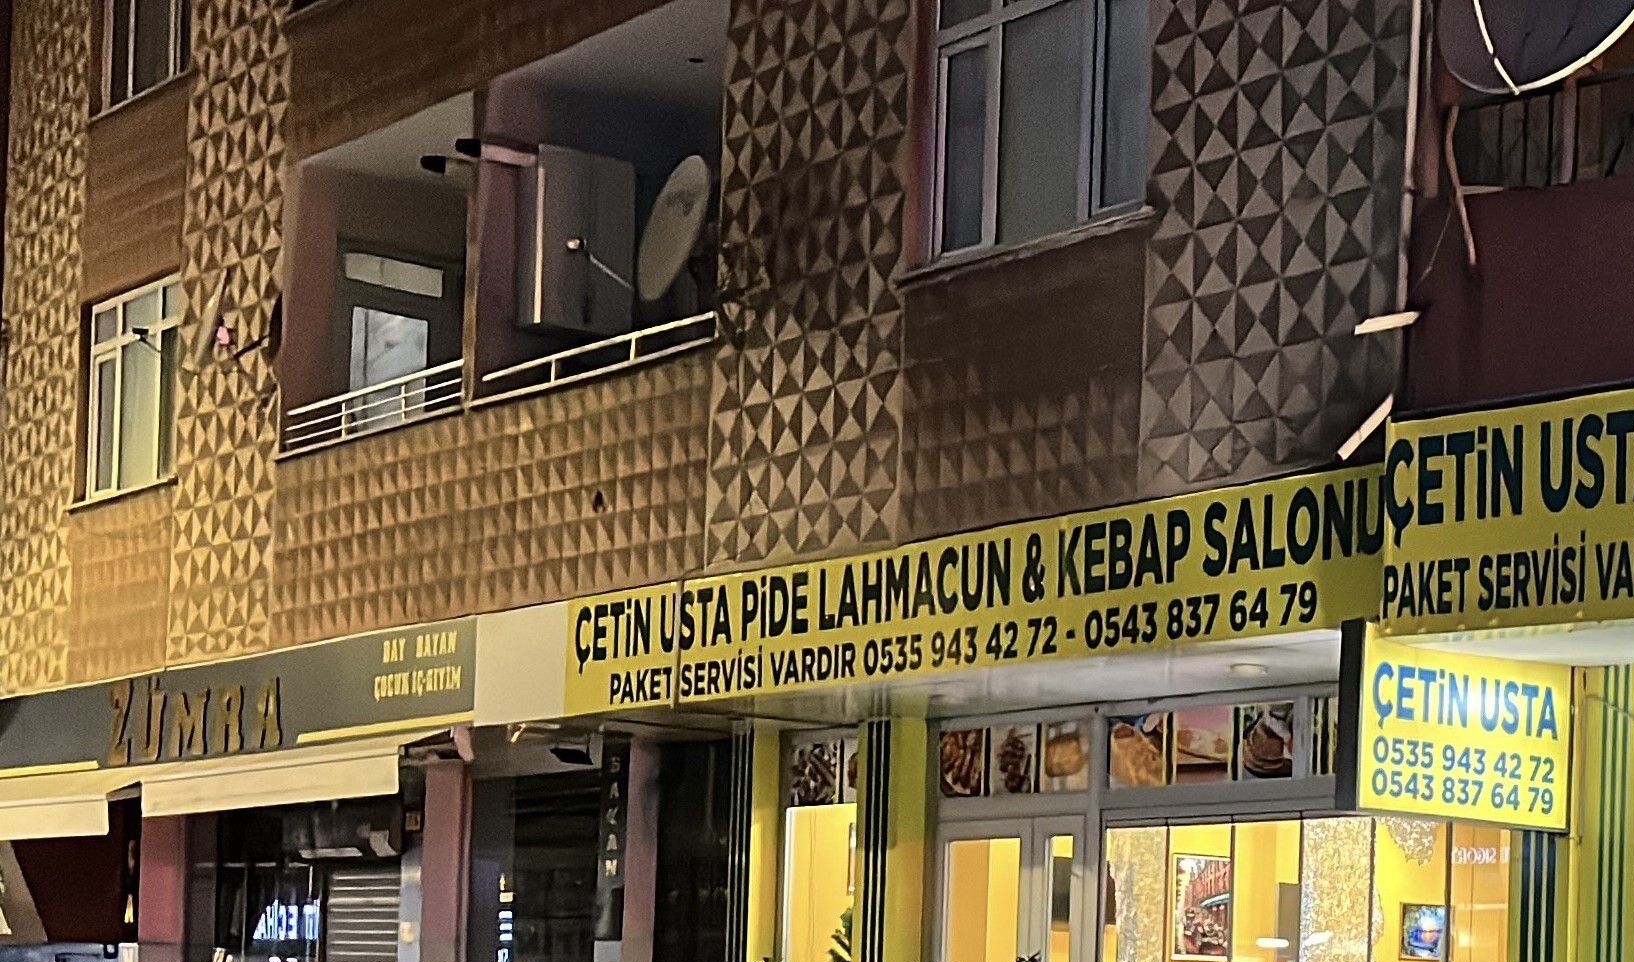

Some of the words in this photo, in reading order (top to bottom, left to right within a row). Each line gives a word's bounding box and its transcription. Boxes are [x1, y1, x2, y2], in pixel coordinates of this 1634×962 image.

[660, 584, 732, 653] USTA
[819, 537, 1012, 631] LAHMACUN
[1022, 533, 1045, 603] &
[1057, 509, 1191, 598] KEBAP
[1202, 475, 1387, 577] SALONU
[1383, 557, 1470, 619] PAKET
[1478, 529, 1586, 611] SERVİSİ
[609, 666, 672, 705] PAKET
[680, 645, 763, 697] SERVİSİ
[770, 642, 856, 687] VARDIR
[863, 634, 922, 676] 0535
[931, 626, 978, 667] 943
[985, 621, 1018, 660] 42
[1027, 616, 1058, 657] 72
[1084, 601, 1157, 649] 0543
[1166, 593, 1220, 640] 837
[1229, 587, 1268, 632] 64
[1280, 580, 1317, 626] 79
[108, 676, 284, 765] ZÜMRA
[1480, 677, 1558, 741] USTA
[1372, 768, 1434, 801] 0543
[1442, 776, 1484, 806] 837
[1491, 782, 1520, 811] 64
[1528, 787, 1554, 815] 79
[1373, 735, 1434, 769] 0535
[1442, 744, 1486, 776] 943
[1493, 752, 1522, 780] 42
[1529, 755, 1555, 783] 72
